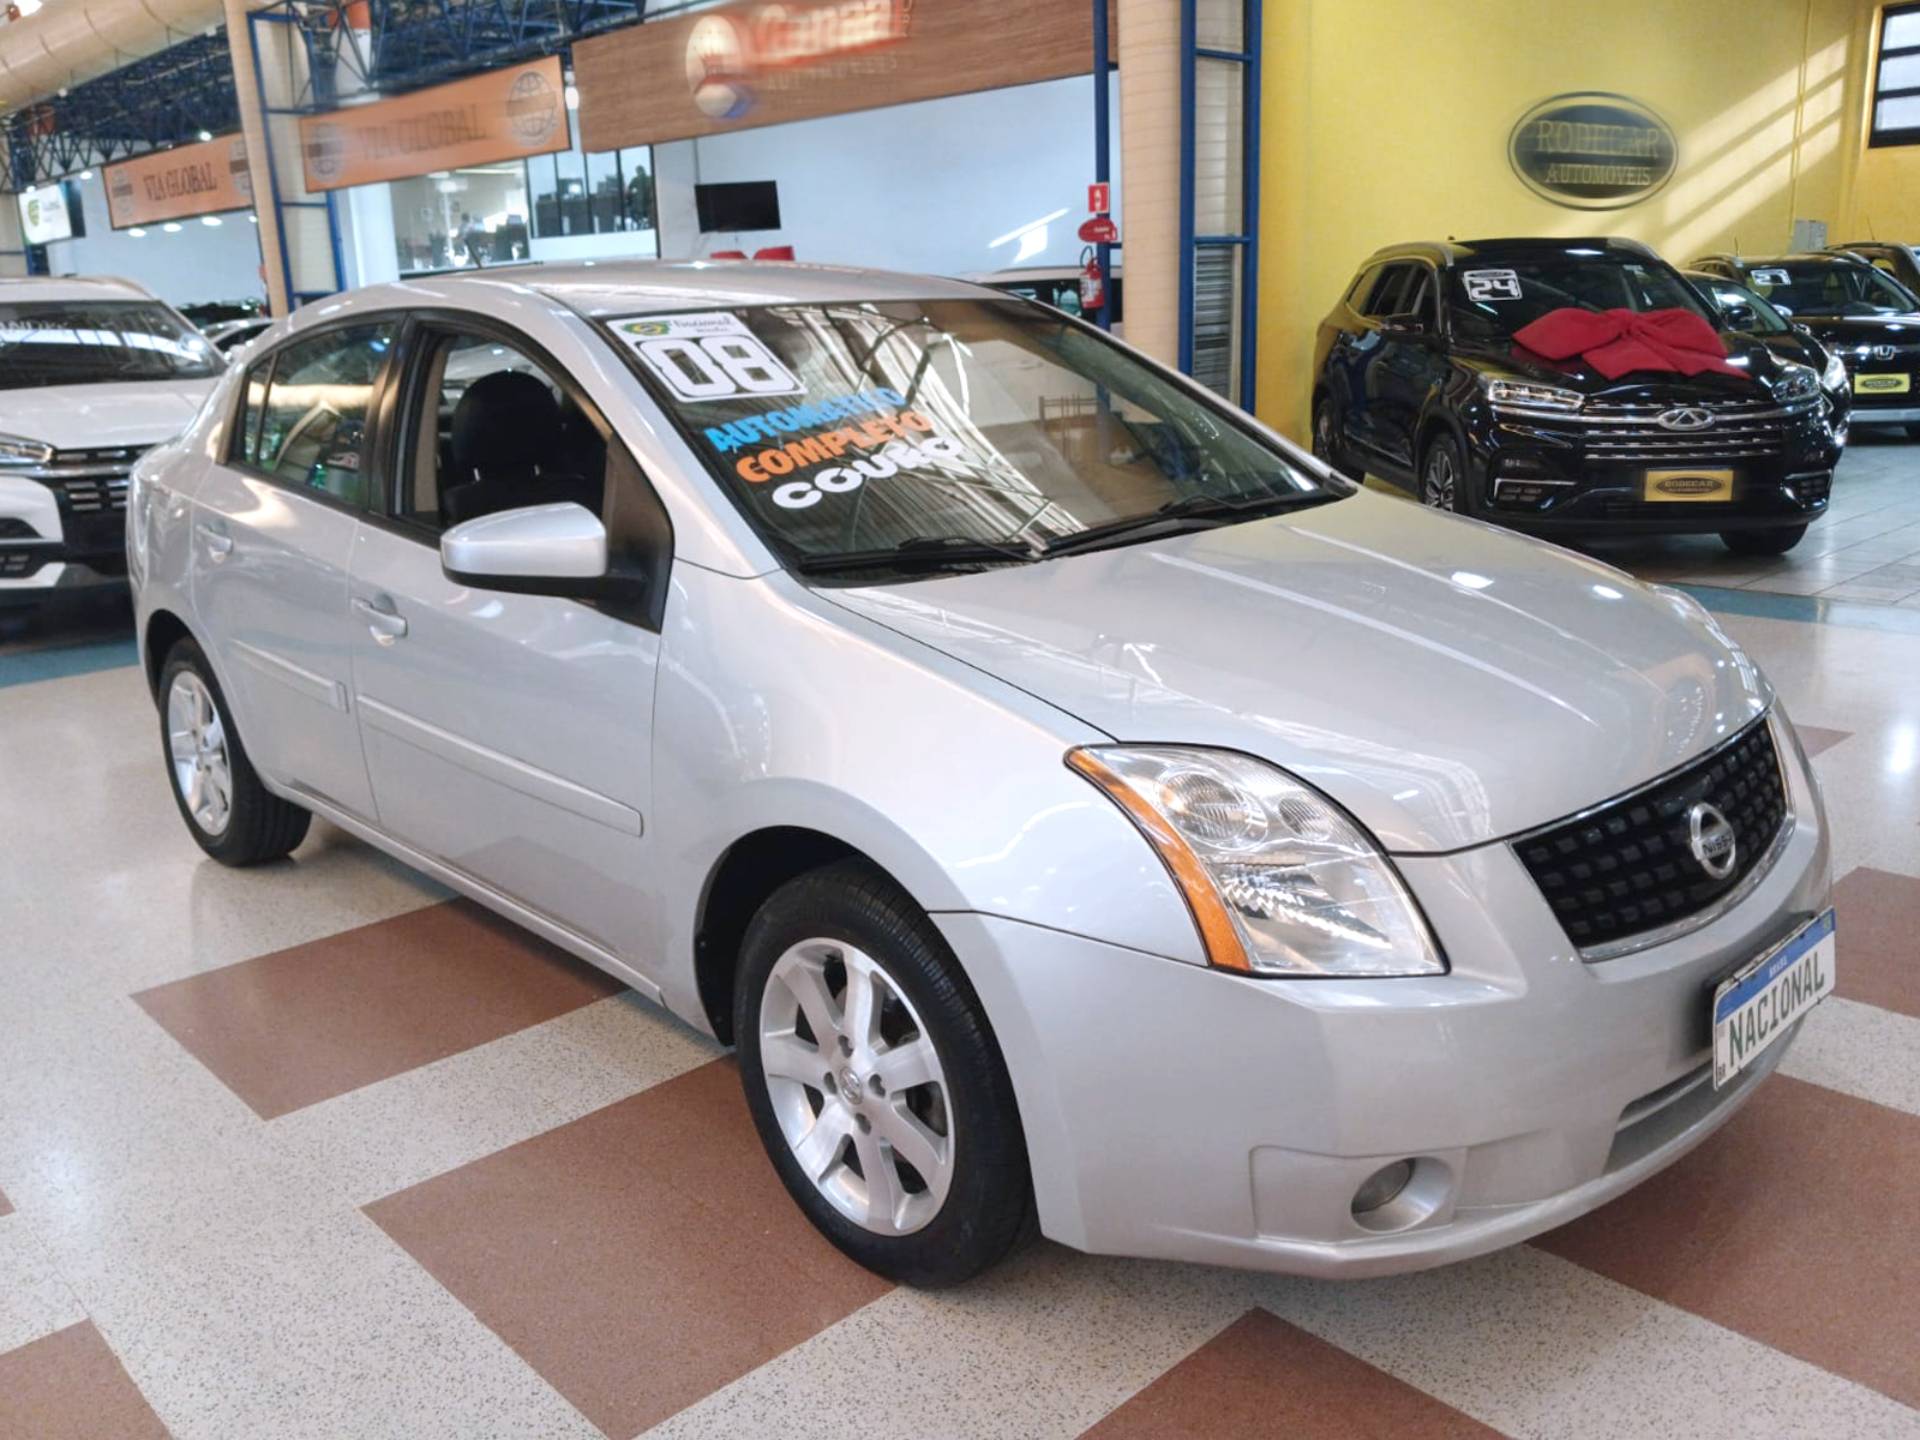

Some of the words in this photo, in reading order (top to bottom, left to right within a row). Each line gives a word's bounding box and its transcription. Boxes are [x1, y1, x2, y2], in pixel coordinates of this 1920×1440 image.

[166, 162, 217, 196] GLOBAL
[1471, 279, 1519, 299] 24
[638, 335, 796, 397] 08
[736, 409, 934, 483] COMPLETO
[1728, 951, 1825, 1067] NACIONAL
